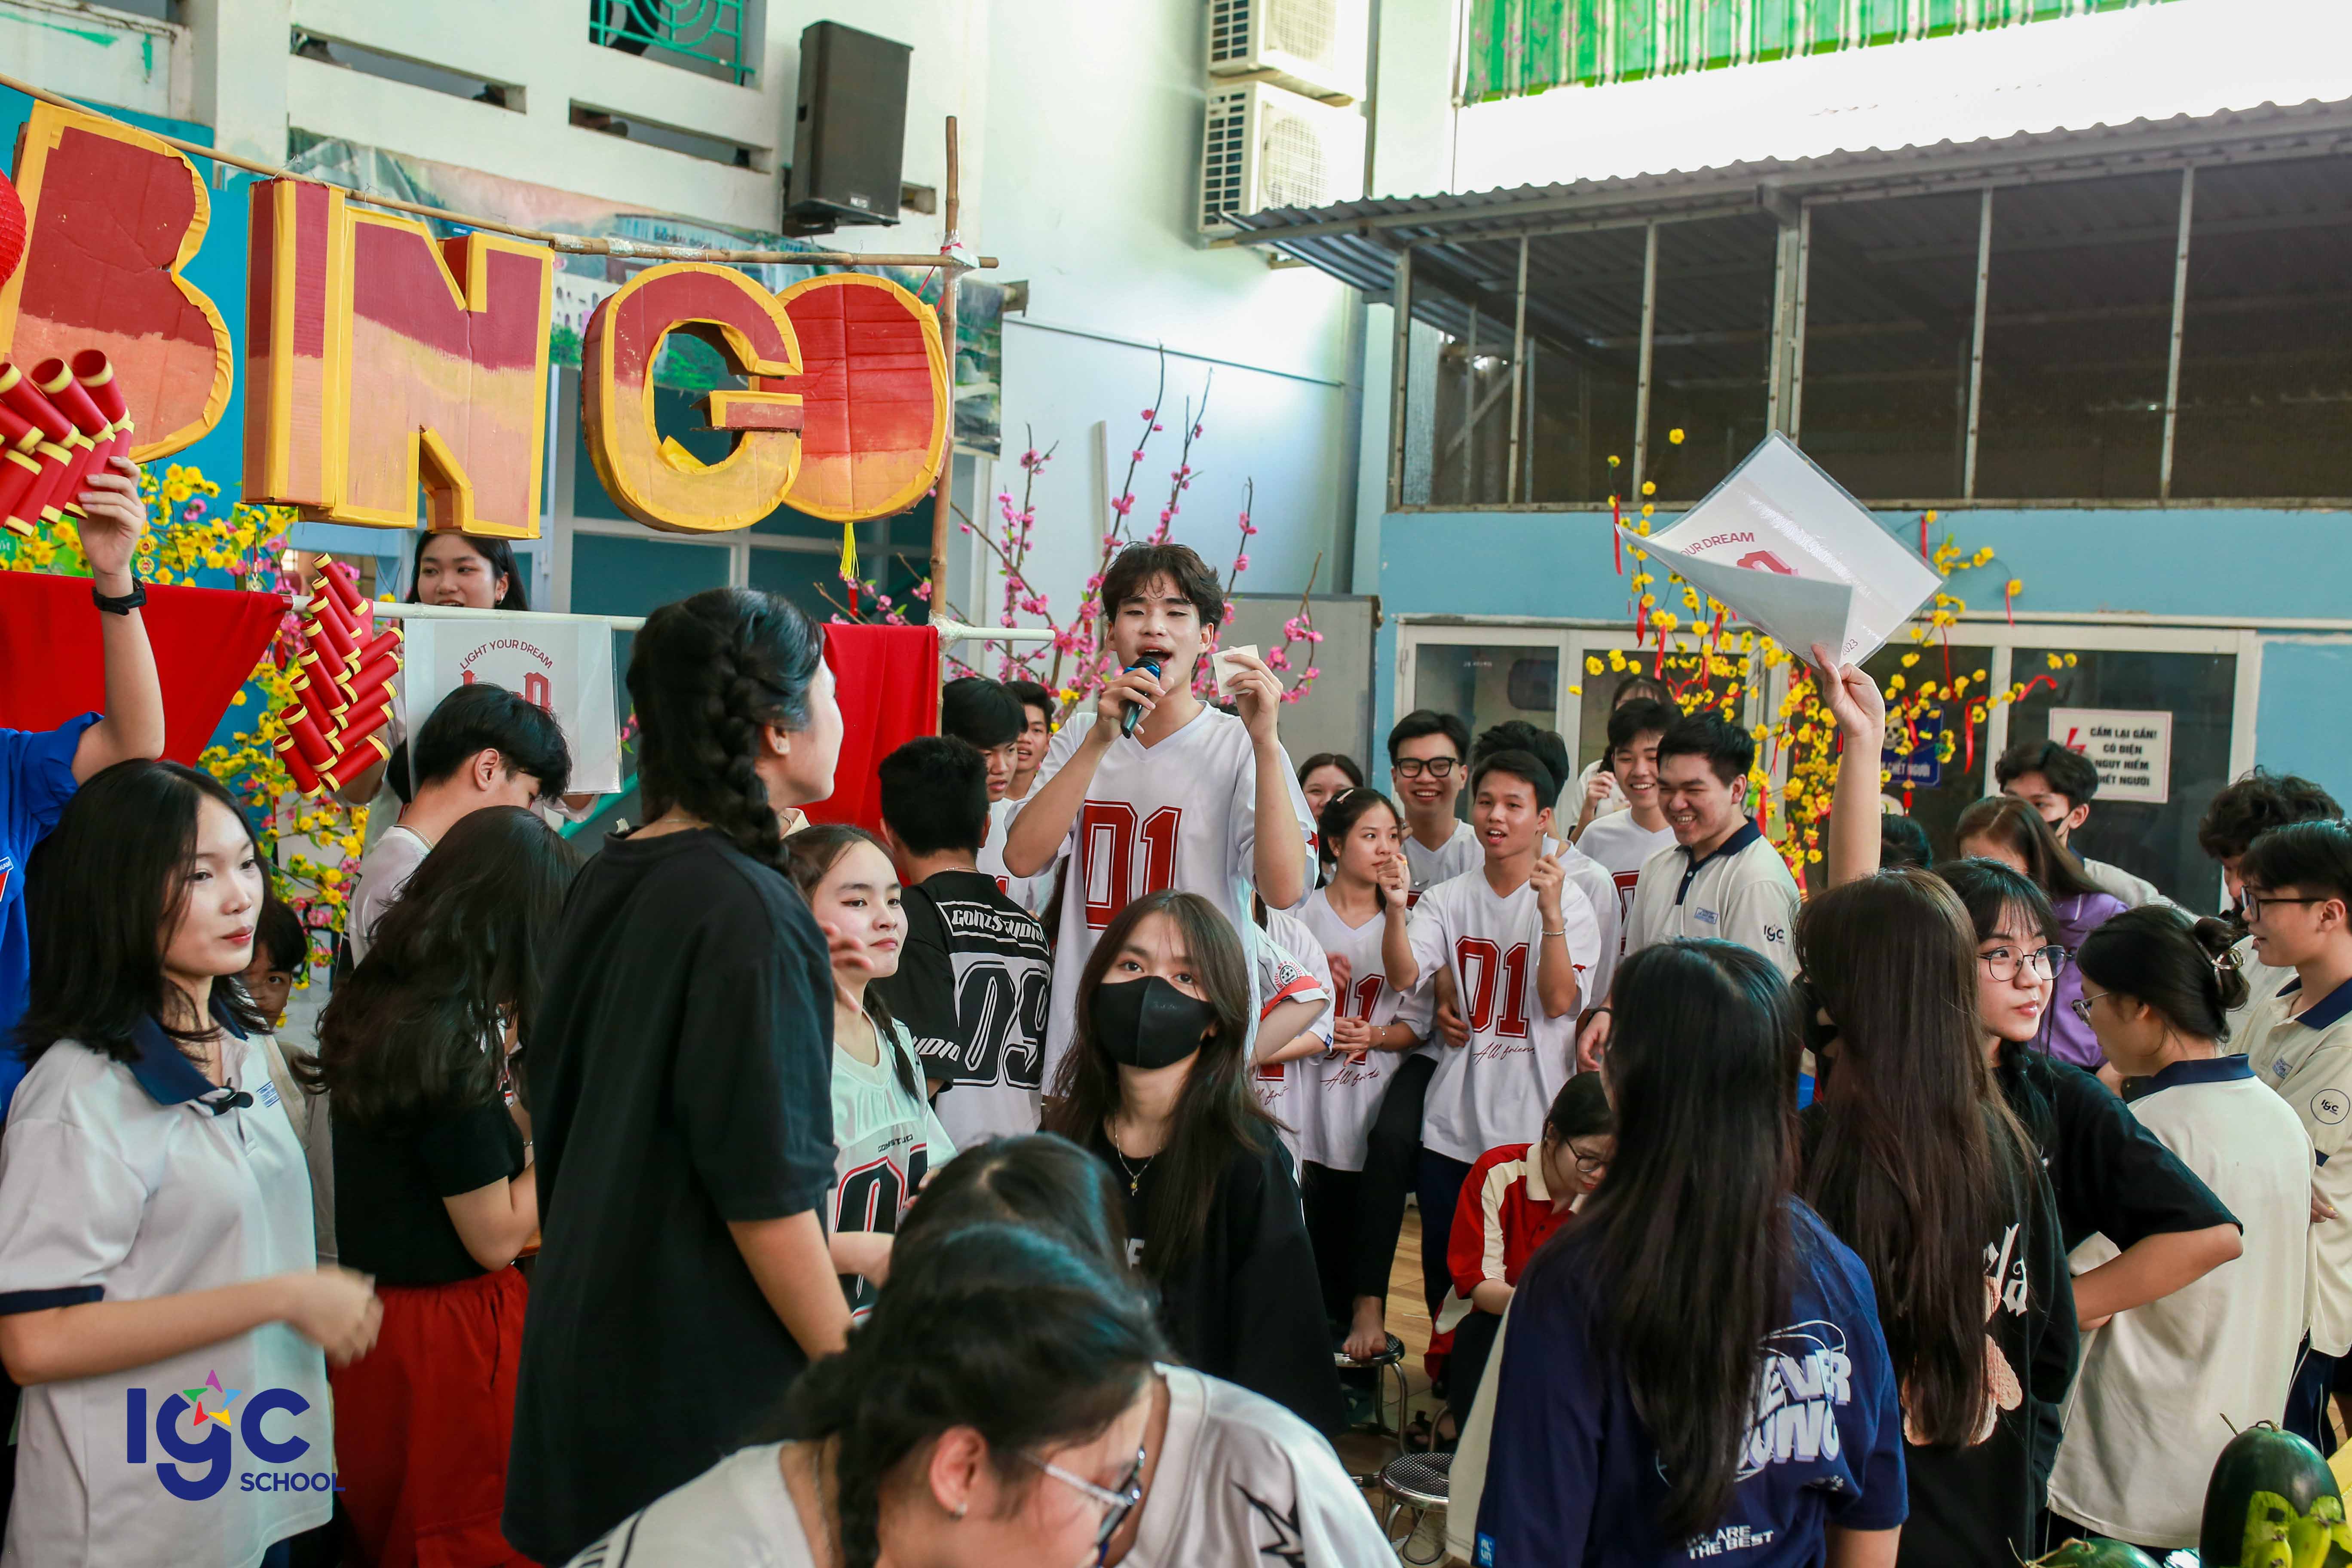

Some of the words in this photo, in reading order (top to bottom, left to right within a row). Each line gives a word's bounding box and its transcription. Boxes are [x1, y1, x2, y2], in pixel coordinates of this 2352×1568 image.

[0, 100, 950, 540] BINGO
[1701, 532, 1754, 548] DREAM
[459, 643, 487, 670] LIGHT
[489, 639, 519, 650] YOUR
[521, 641, 553, 669] DREAM
[2095, 760, 2121, 769] NGUY
[1082, 799, 1182, 929] 01
[1456, 936, 1530, 1038] 01
[1687, 1540, 1722, 1559] THE
[1725, 1530, 1774, 1551] BEST
[1716, 1525, 1751, 1543] ARE
